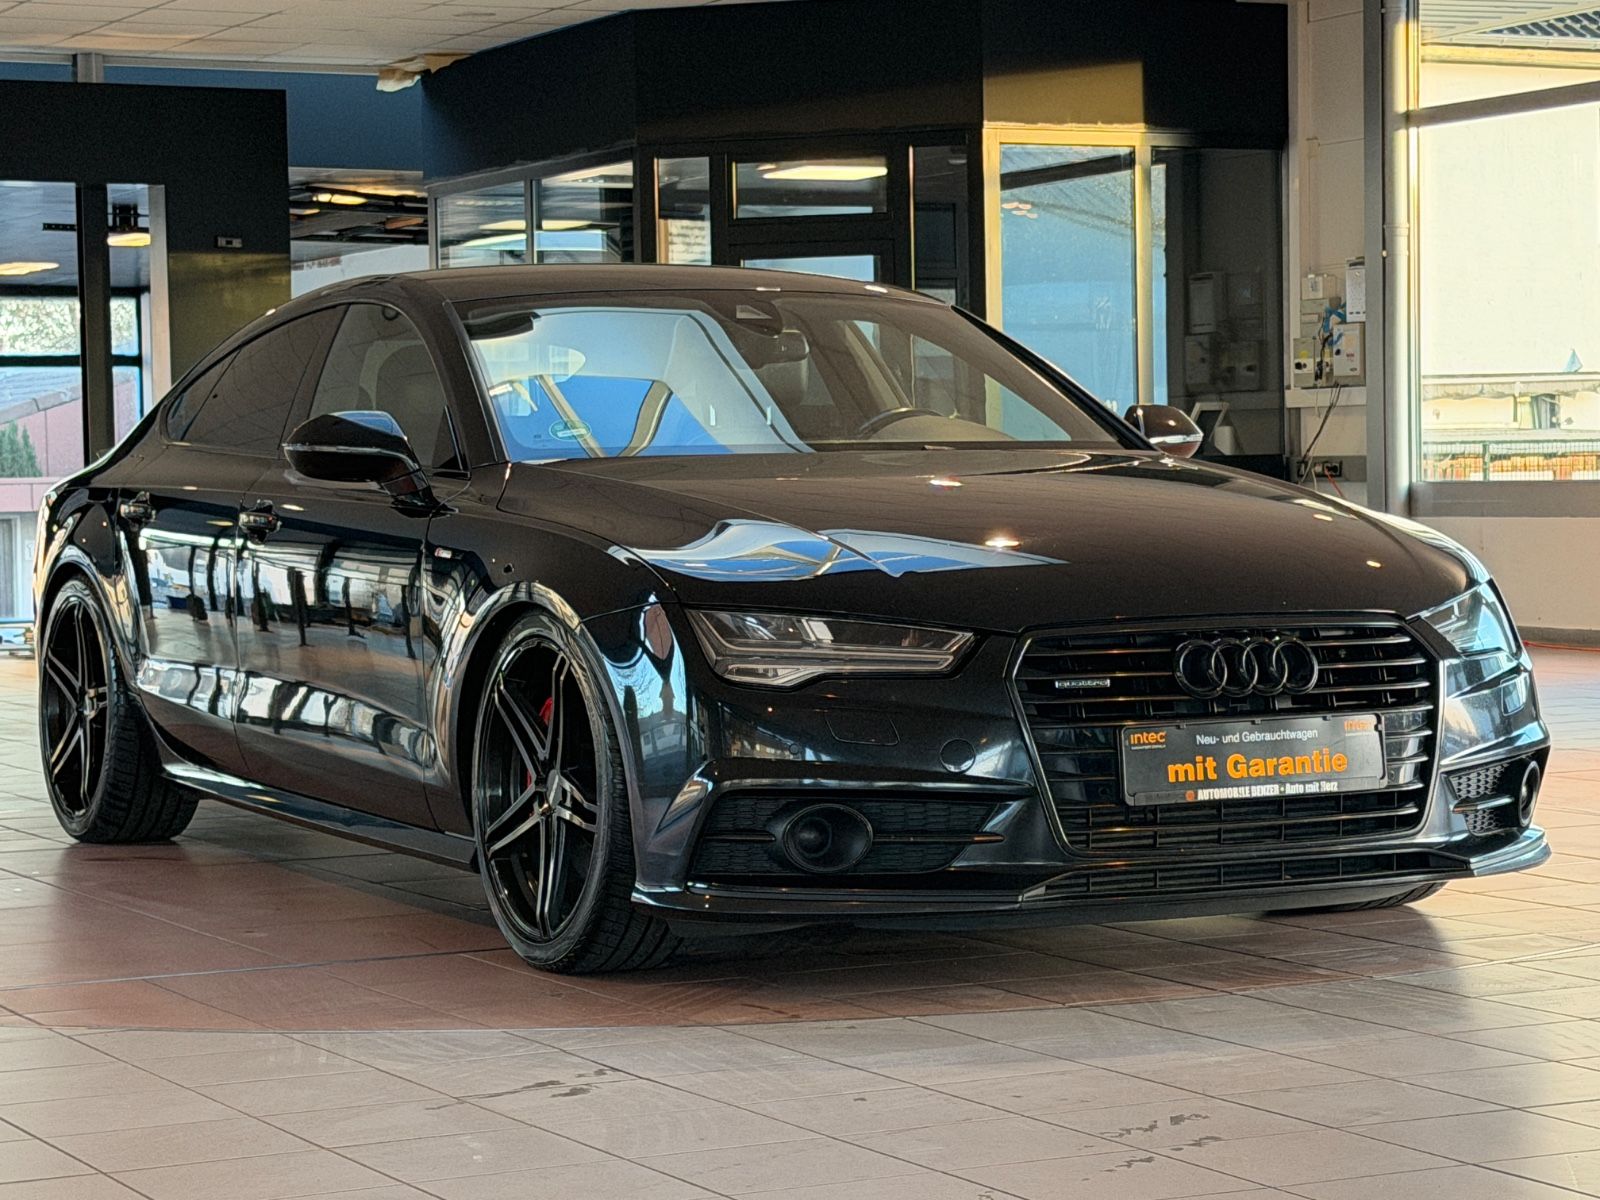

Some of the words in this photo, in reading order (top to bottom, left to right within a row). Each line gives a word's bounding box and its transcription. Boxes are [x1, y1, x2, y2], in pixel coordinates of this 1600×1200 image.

[1130, 731, 1166, 745] intec
[1196, 734, 1219, 745] Neu-
[1222, 732, 1240, 744] und
[1242, 729, 1318, 742] Gebrauchtwagen
[1168, 755, 1217, 782] mit
[1226, 748, 1348, 779] Garantie
[1197, 786, 1250, 800] AUTOMOBILE
